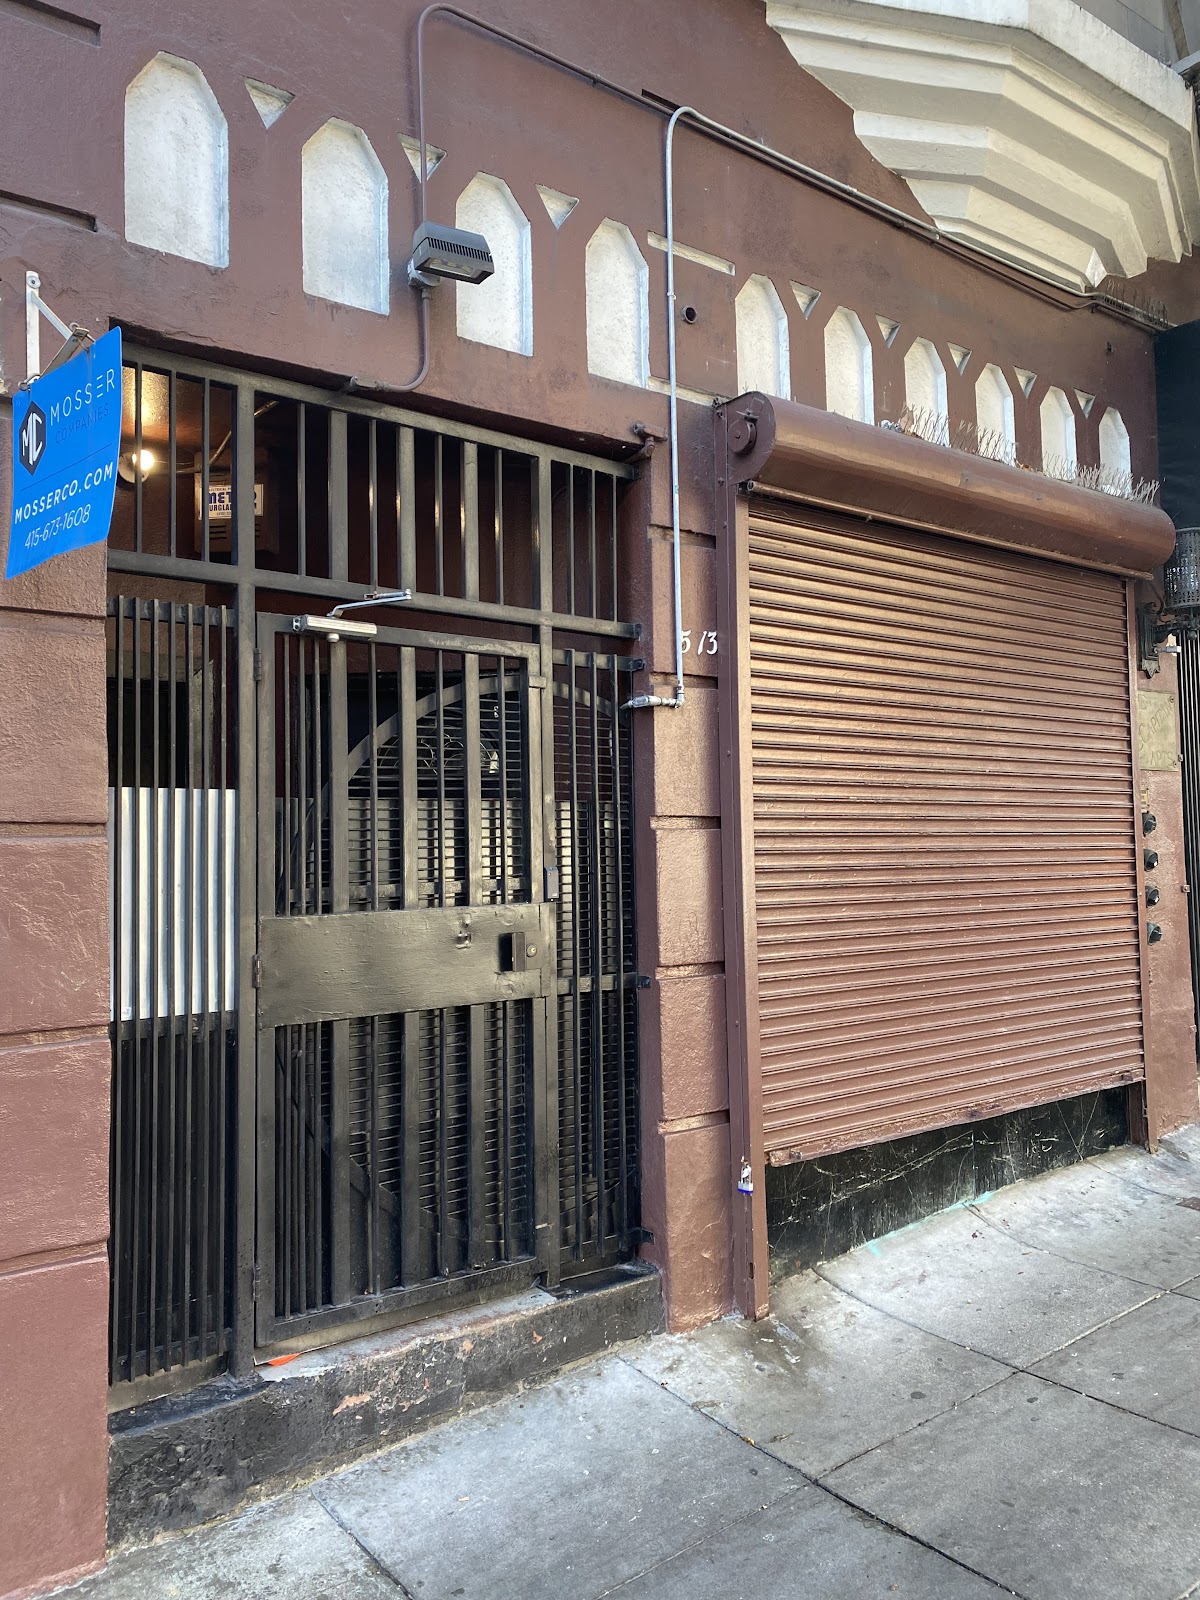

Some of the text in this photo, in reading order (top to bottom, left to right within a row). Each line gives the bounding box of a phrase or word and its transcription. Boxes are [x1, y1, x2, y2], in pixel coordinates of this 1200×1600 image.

[50, 368, 115, 426] MOSSER
[56, 402, 109, 444] COMPANIES
[14, 461, 114, 525] MOSSERCO.COM
[24, 503, 92, 550] 415-673-1608
[681, 629, 718, 655] 513
